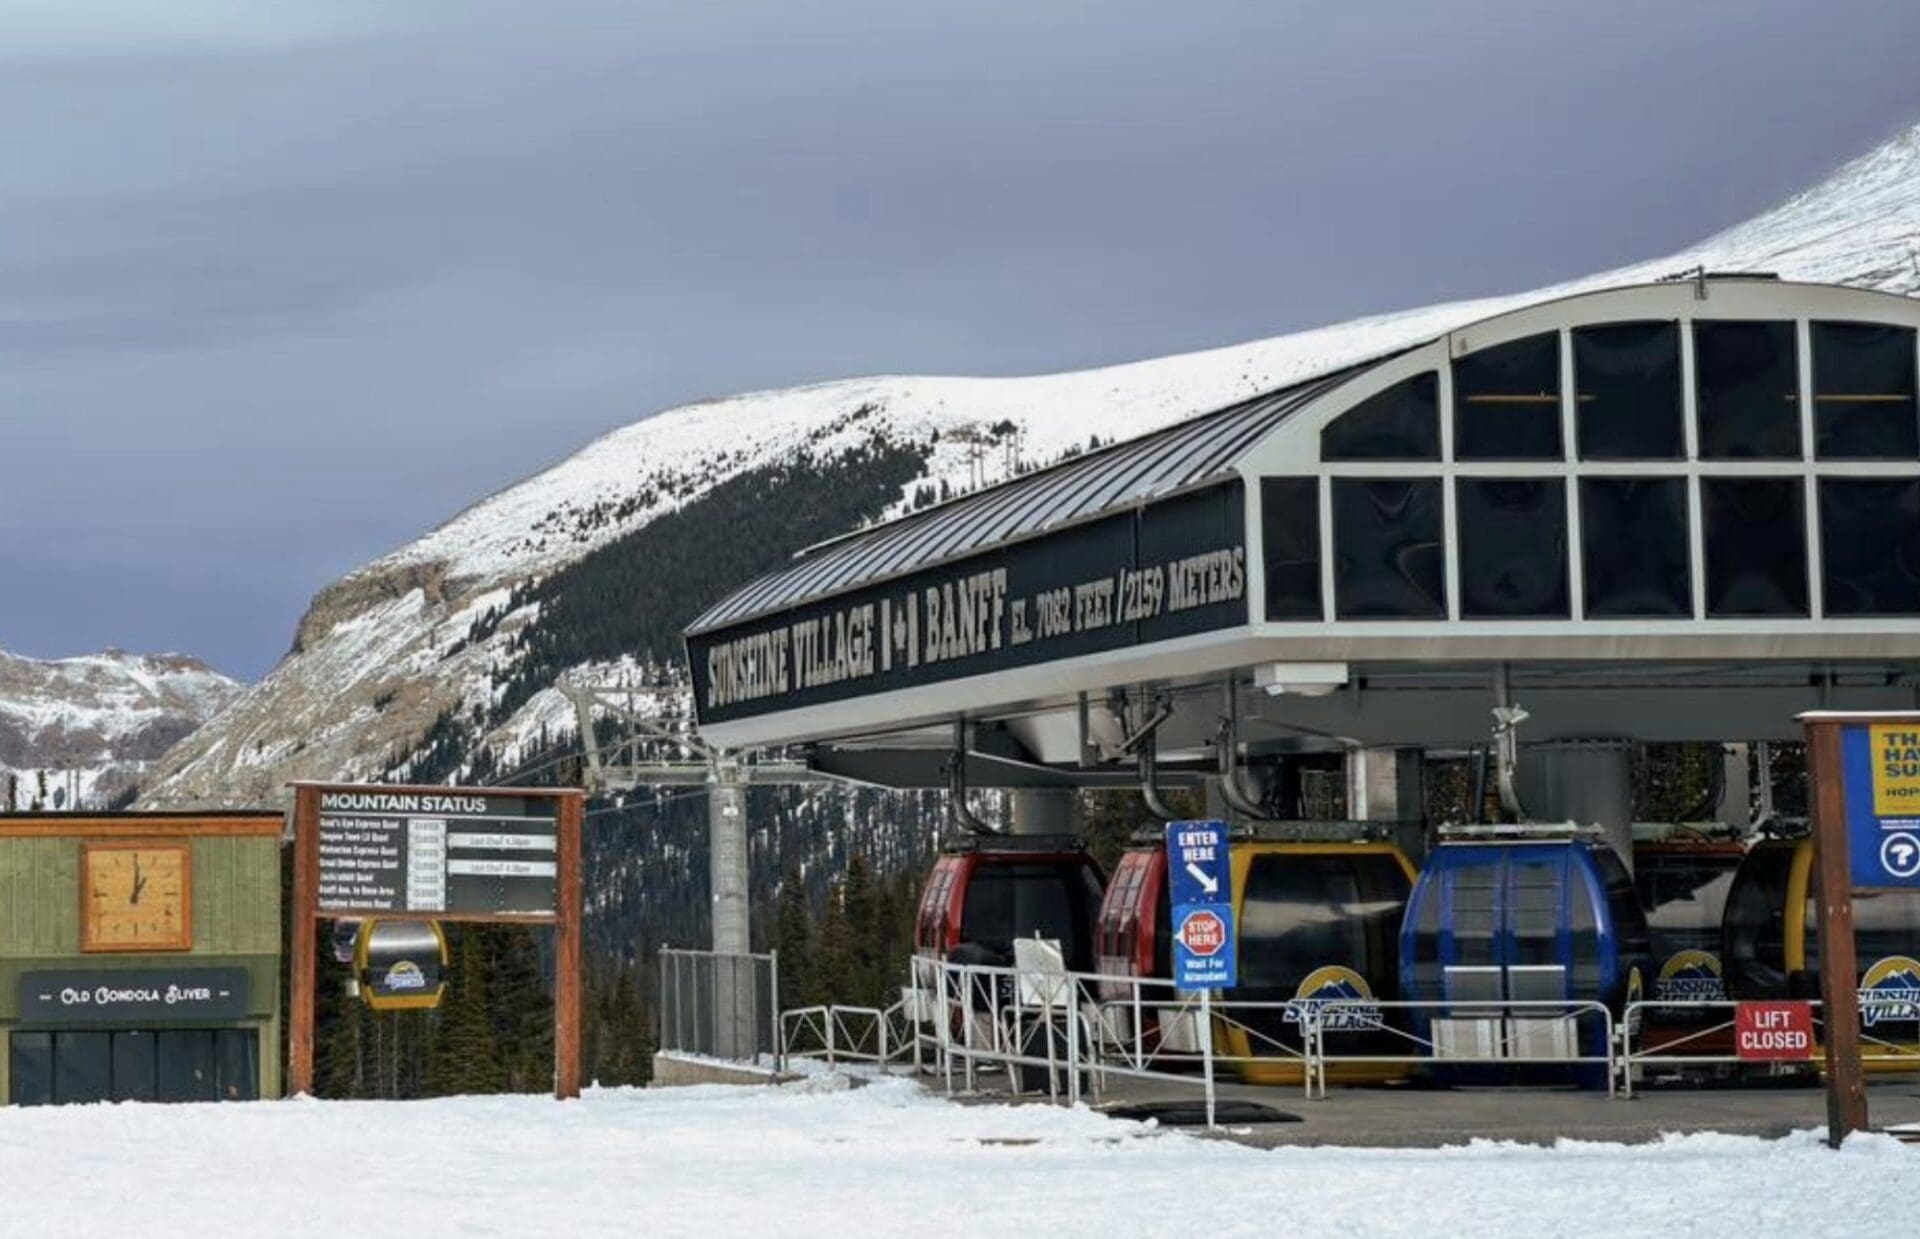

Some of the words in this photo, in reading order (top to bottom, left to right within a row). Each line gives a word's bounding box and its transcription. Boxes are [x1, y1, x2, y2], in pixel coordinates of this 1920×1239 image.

[708, 627, 789, 708] SUNSHINE
[793, 604, 874, 690] VILLAGE
[926, 567, 1007, 664] BANFF
[1037, 587, 1071, 639] 7082
[1167, 546, 1244, 612] METERS
[1883, 733, 1920, 746] TH
[1884, 748, 1920, 762] HA
[1885, 763, 1920, 778] SU
[321, 793, 418, 811] MOUNTAIN
[422, 796, 486, 812] STATUS
[1178, 831, 1219, 846] ENTER
[1183, 846, 1216, 862] HERE
[1188, 920, 1218, 933] STOP
[1188, 932, 1218, 946] HERE
[61, 987, 90, 1005] OLD
[95, 985, 160, 1005] GONDOLA
[1755, 1010, 1792, 1028] LIFT
[1741, 1031, 1808, 1050] CLOSED
